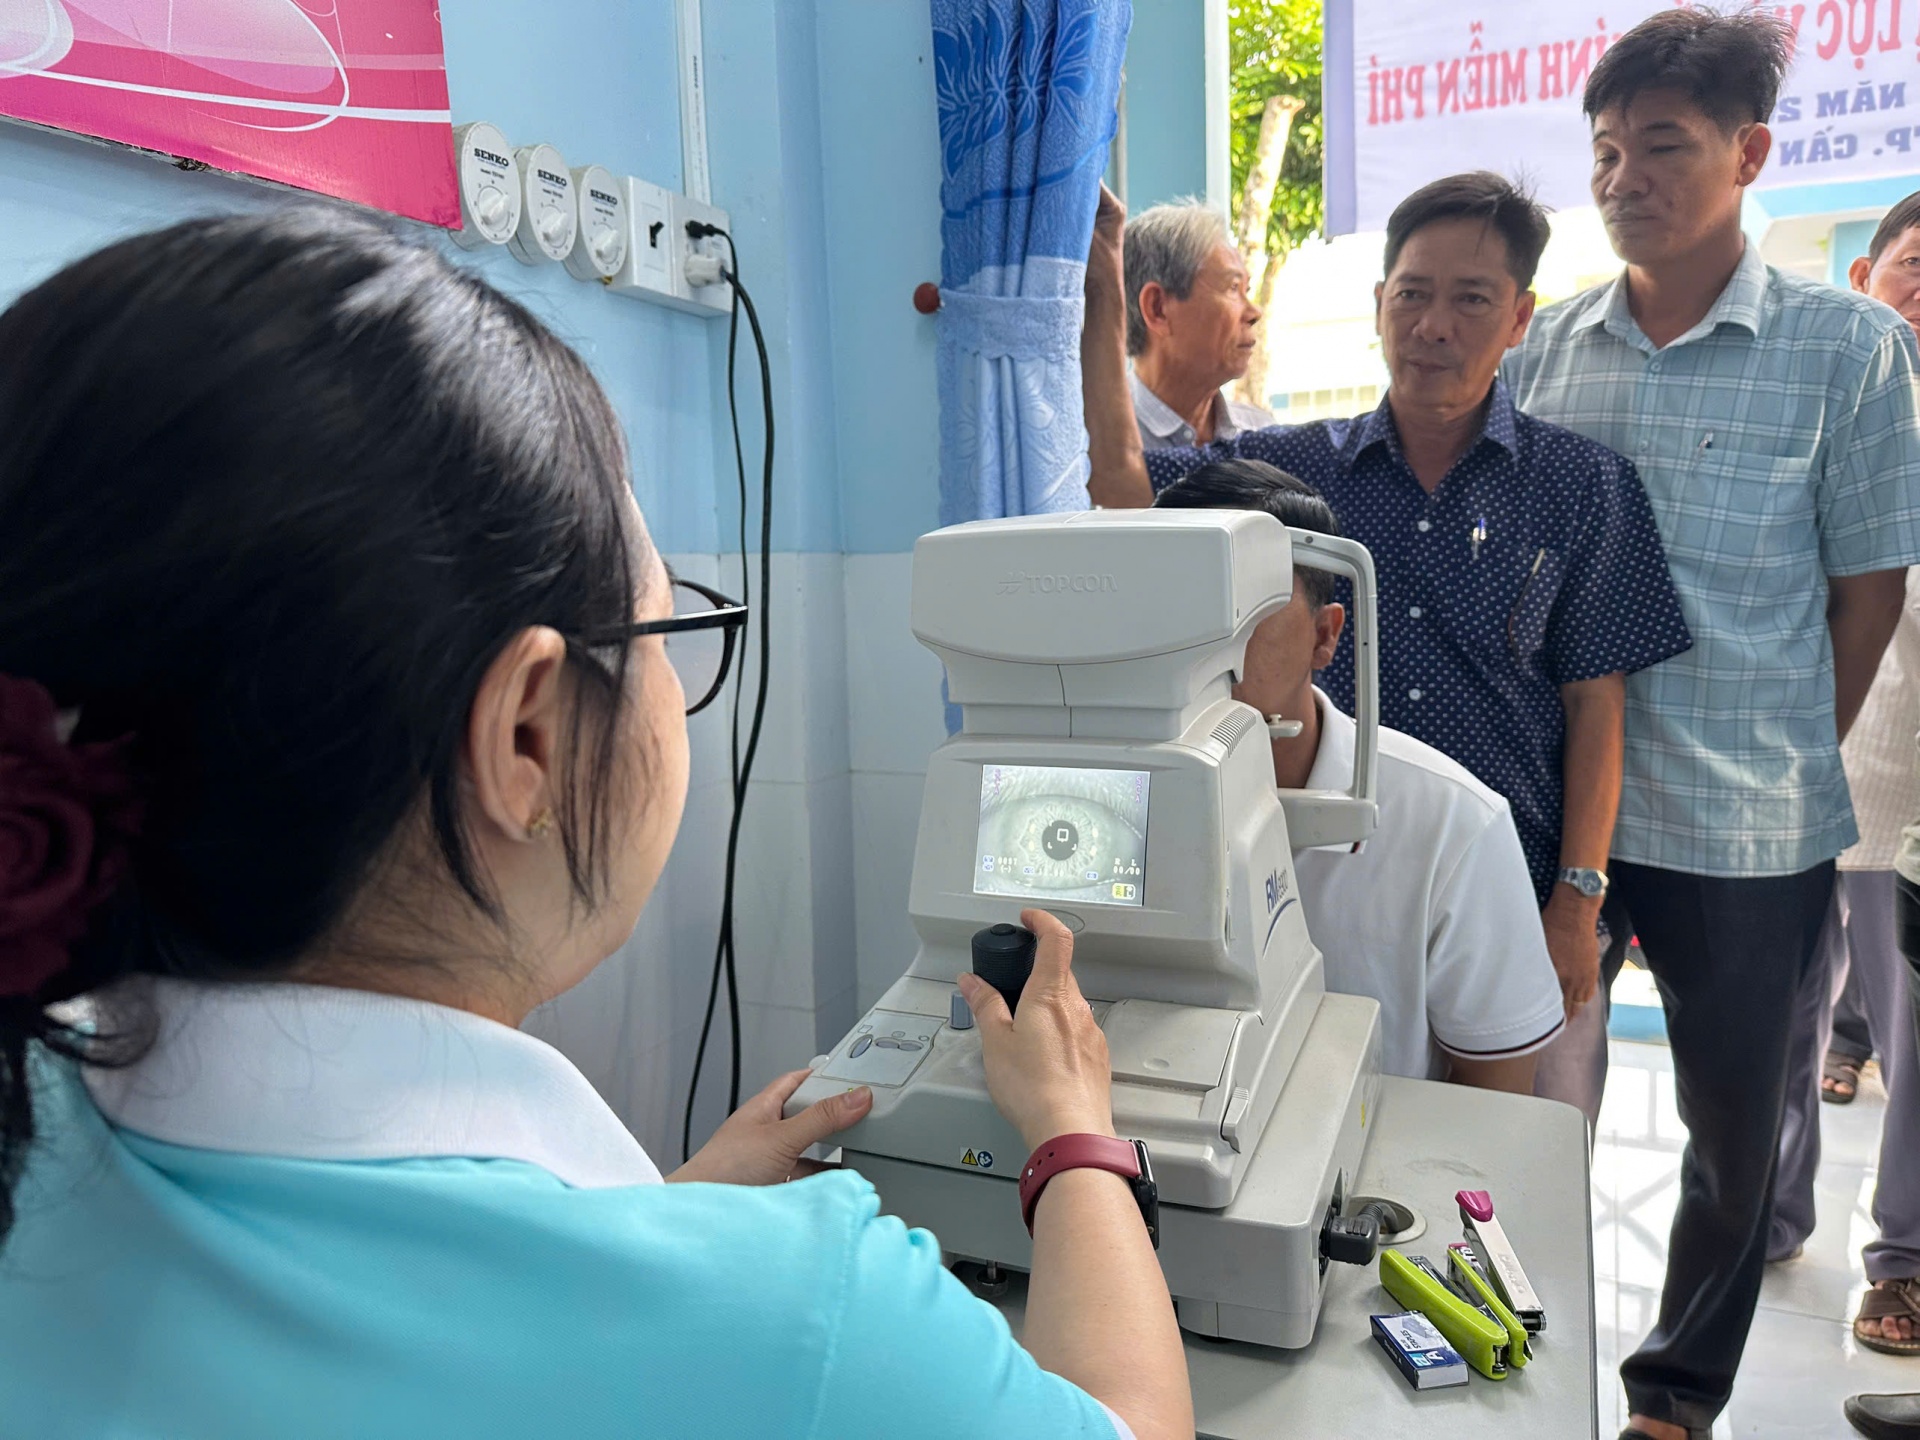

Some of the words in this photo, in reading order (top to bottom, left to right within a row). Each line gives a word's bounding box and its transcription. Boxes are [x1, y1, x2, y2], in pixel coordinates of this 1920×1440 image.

[474, 147, 509, 167] SENKO
[537, 168, 567, 187] SENKO
[590, 189, 618, 206] SENKO
